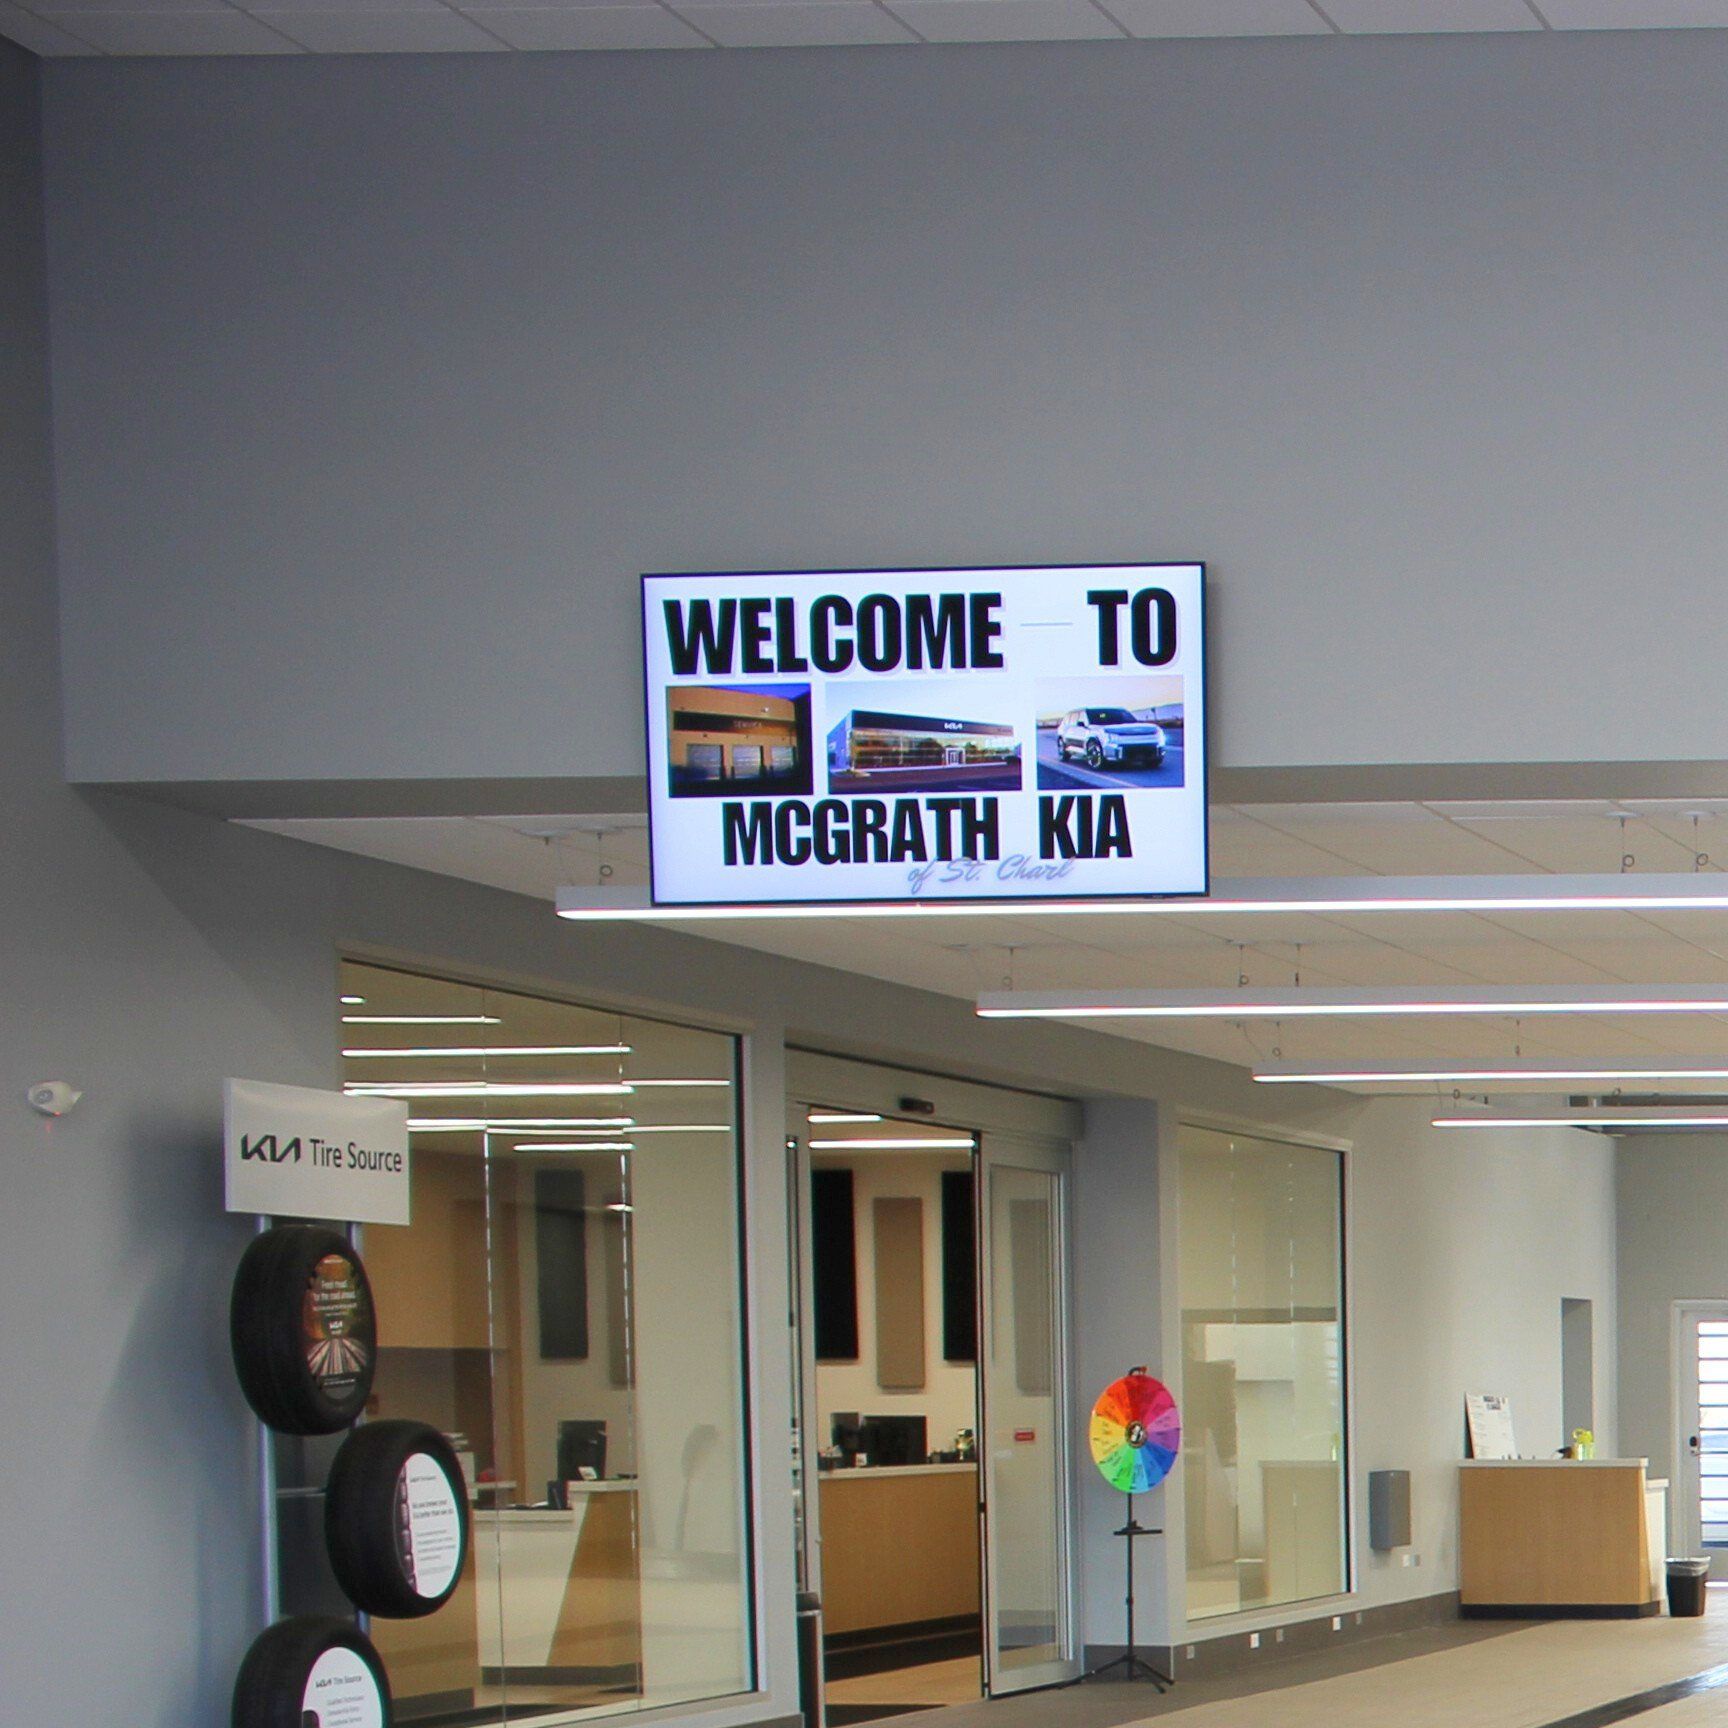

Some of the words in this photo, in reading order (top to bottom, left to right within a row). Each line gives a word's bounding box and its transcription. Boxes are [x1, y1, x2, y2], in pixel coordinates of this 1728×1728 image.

[663, 591, 1004, 676] WELCOME
[1086, 587, 1177, 667] TO
[722, 797, 1000, 867] MCGRATH
[1038, 794, 1133, 860] KIA
[906, 856, 940, 895] of
[938, 856, 986, 883] St.
[240, 1132, 302, 1164] KIA
[309, 1138, 342, 1168] Tire
[347, 1141, 402, 1173] Source
